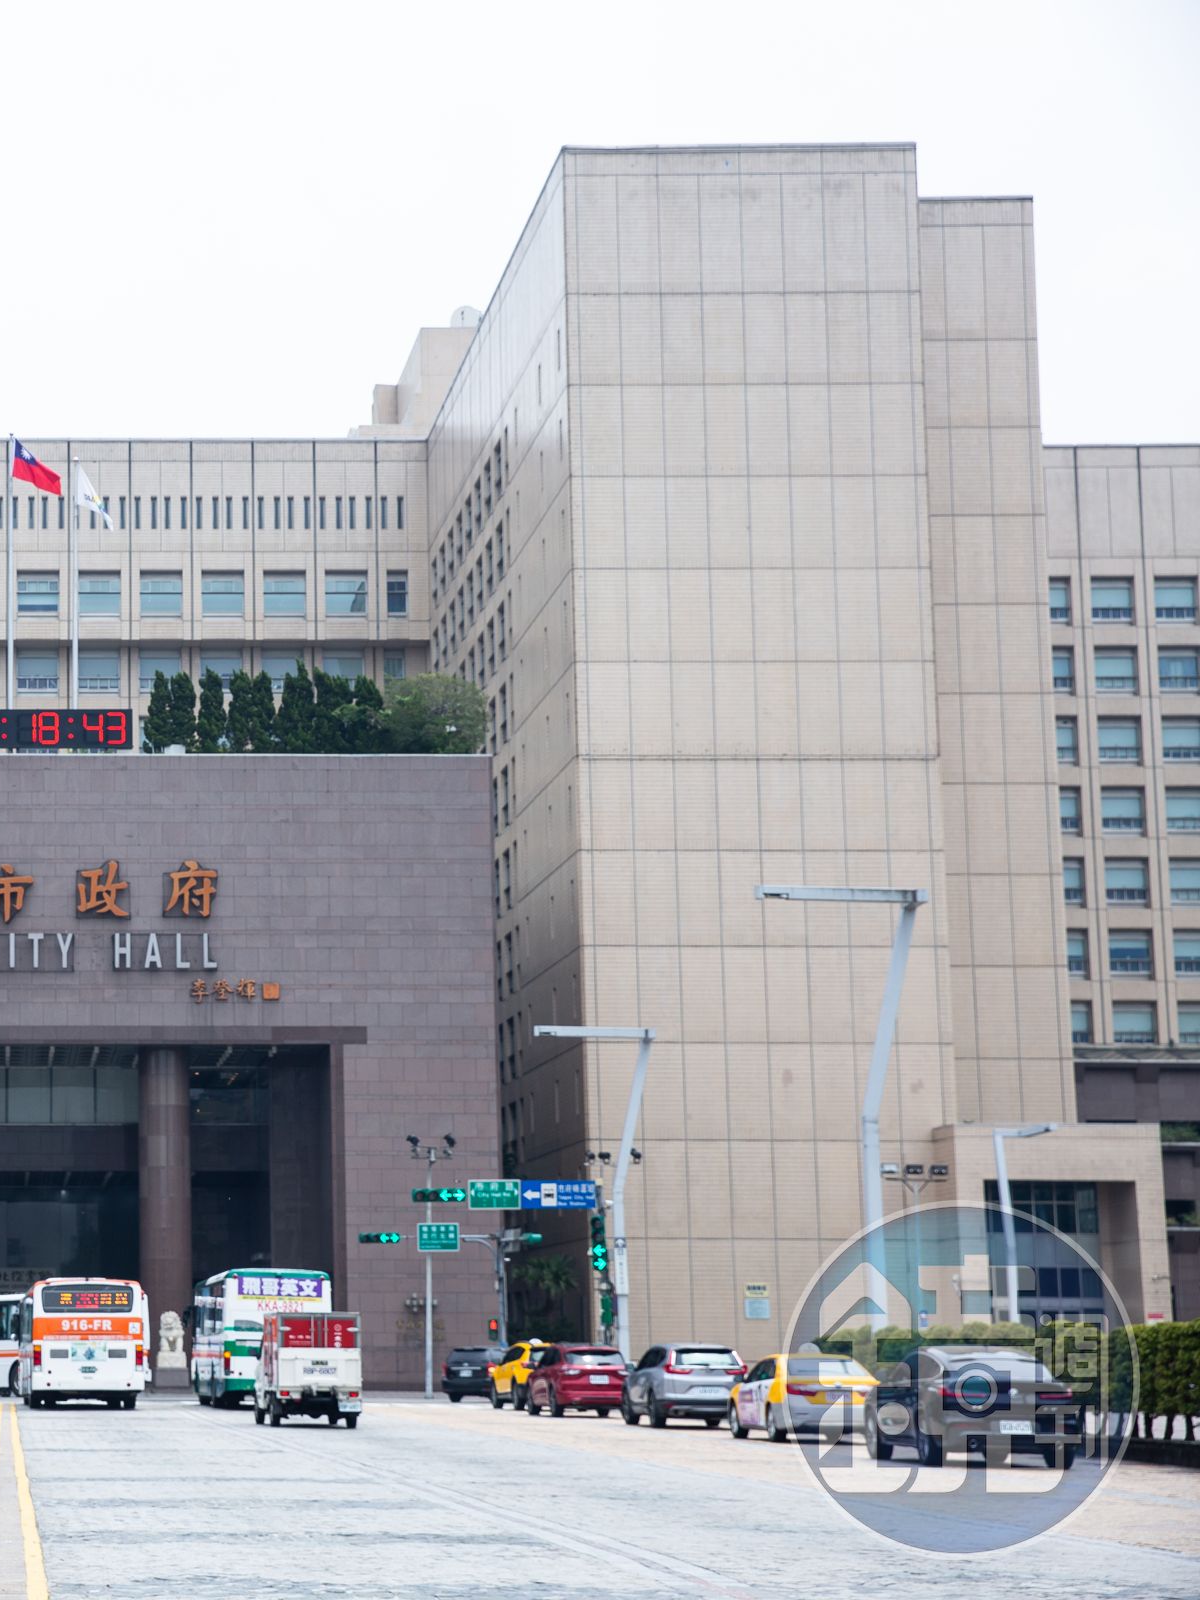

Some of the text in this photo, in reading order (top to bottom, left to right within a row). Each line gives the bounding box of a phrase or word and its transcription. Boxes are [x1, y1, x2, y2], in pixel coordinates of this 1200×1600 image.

[114, 932, 218, 969] HALL
[191, 978, 257, 1003] 李登輝
[241, 1278, 318, 1297] 飛哥英文
[61, 1319, 113, 1331] 916-FR
